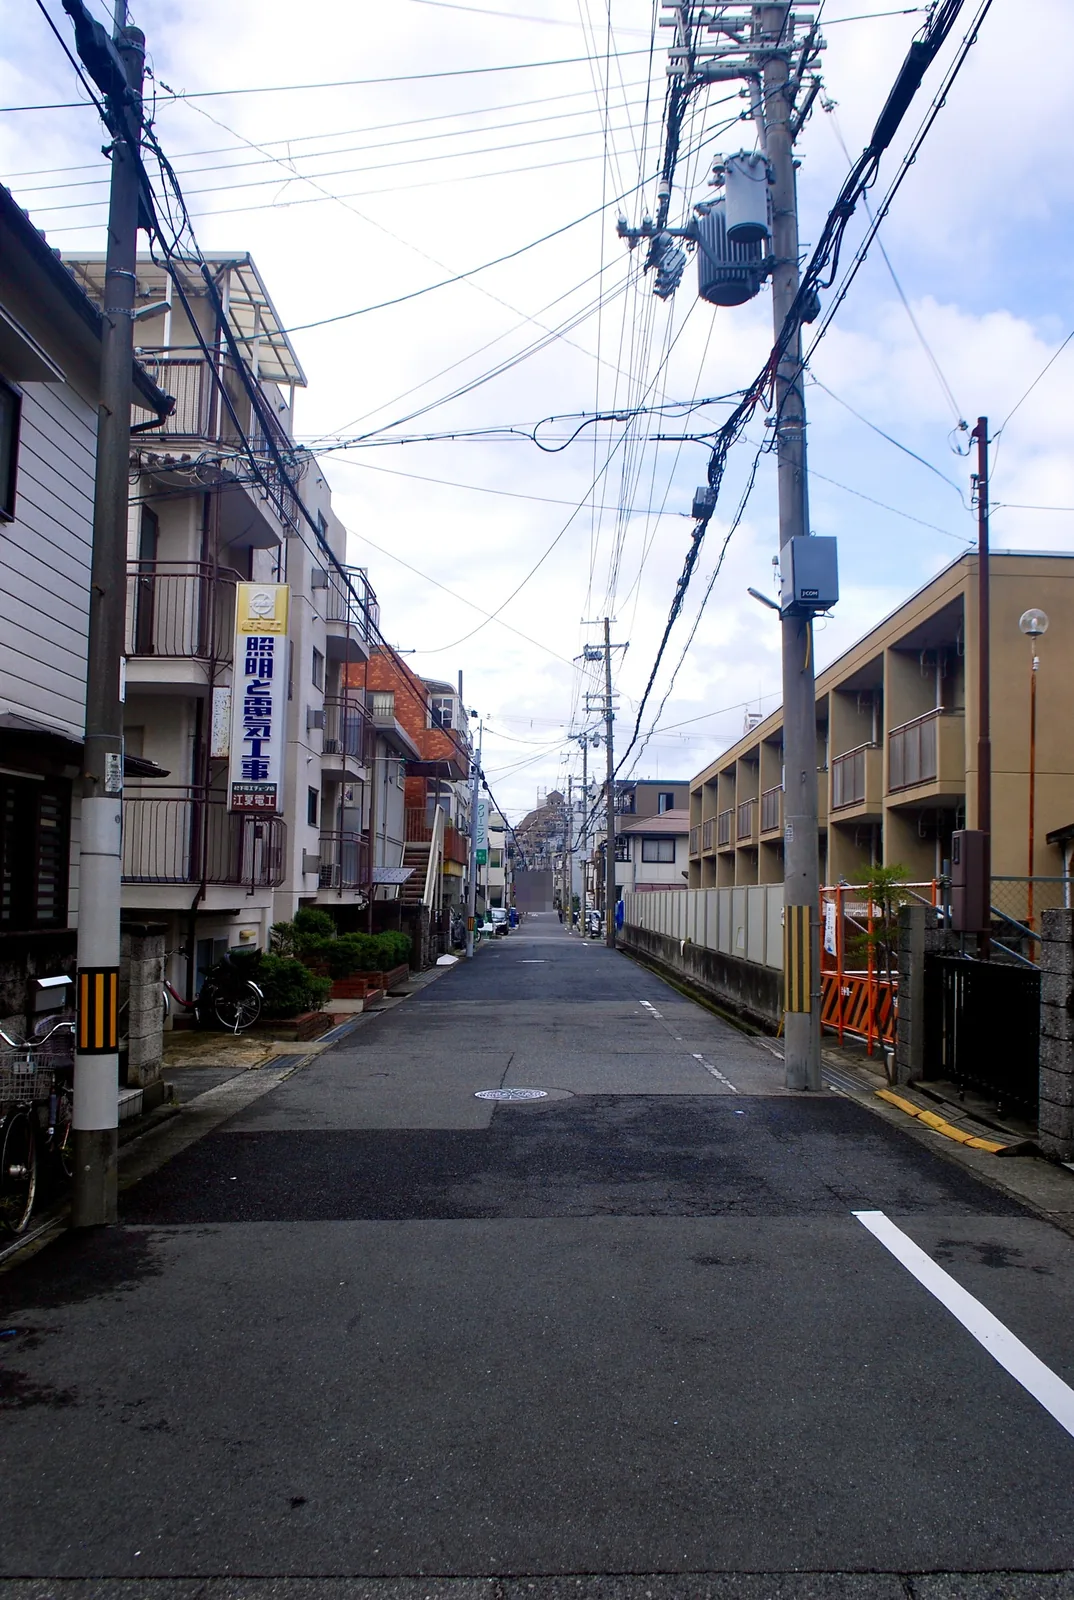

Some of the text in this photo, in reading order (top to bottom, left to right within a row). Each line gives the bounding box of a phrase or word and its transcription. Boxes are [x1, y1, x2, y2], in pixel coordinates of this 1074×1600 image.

[241, 636, 275, 781] 照明と電気工事
[233, 794, 275, 806] 江夏電工
[477, 804, 485, 844] クリーニング
